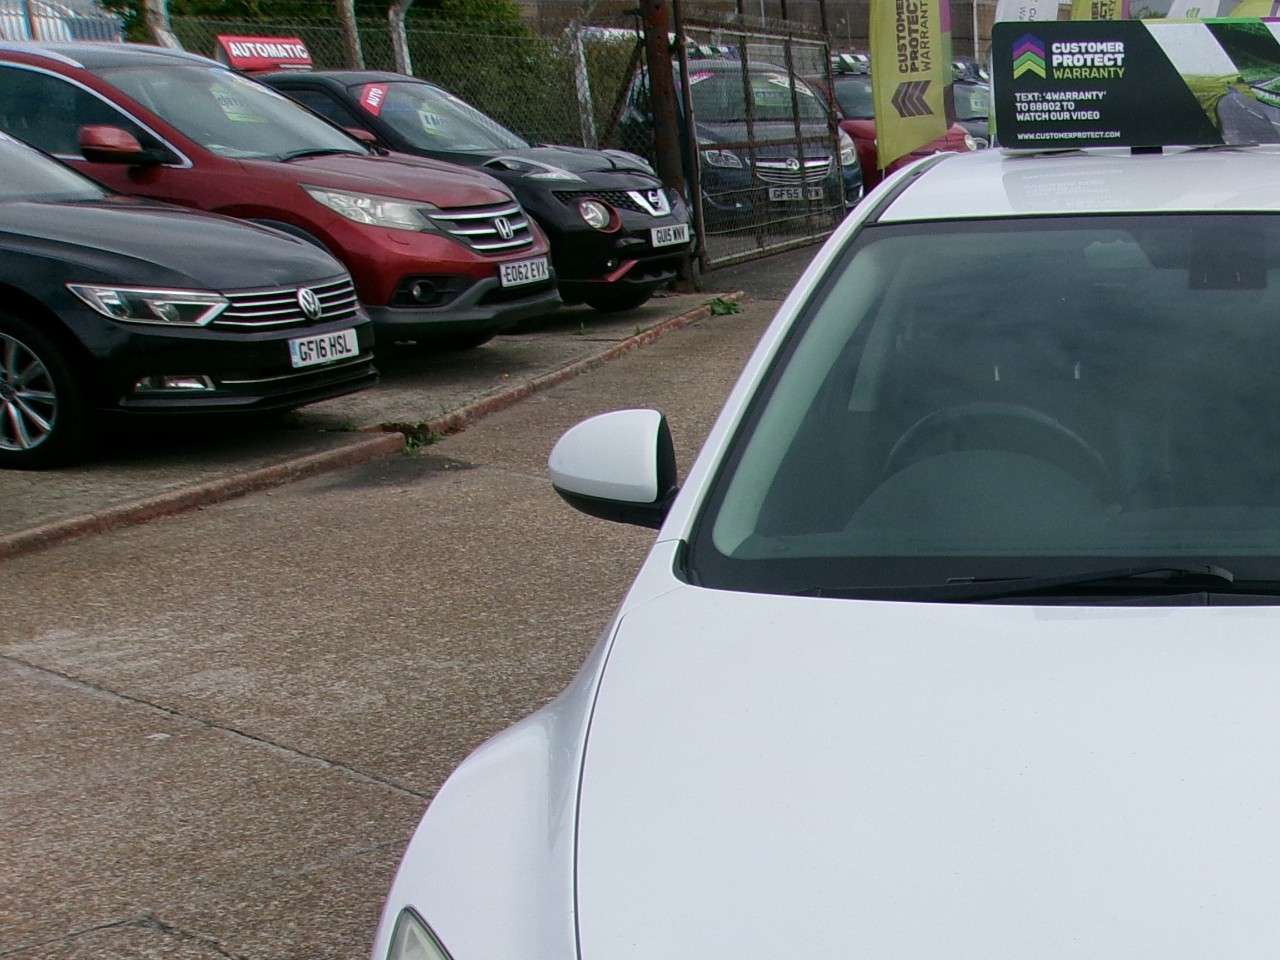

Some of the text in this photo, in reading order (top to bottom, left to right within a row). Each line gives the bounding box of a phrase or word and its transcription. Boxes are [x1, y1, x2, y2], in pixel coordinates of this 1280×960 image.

[896, 0, 908, 74] CUSTOME
[906, 0, 920, 73] PROTEC
[228, 41, 309, 58] AUTOMATIC
[1051, 41, 1125, 53] CUSTOMER
[1051, 54, 1125, 67] PROTECT
[1053, 67, 1126, 80] WARRANTY
[1015, 92, 1042, 102] TEXT:
[1015, 102, 1029, 111] TO
[1062, 101, 1075, 111] TO
[1016, 111, 1100, 121] WATCH OUR VIDEO
[299, 333, 352, 362] GF16 HSL
